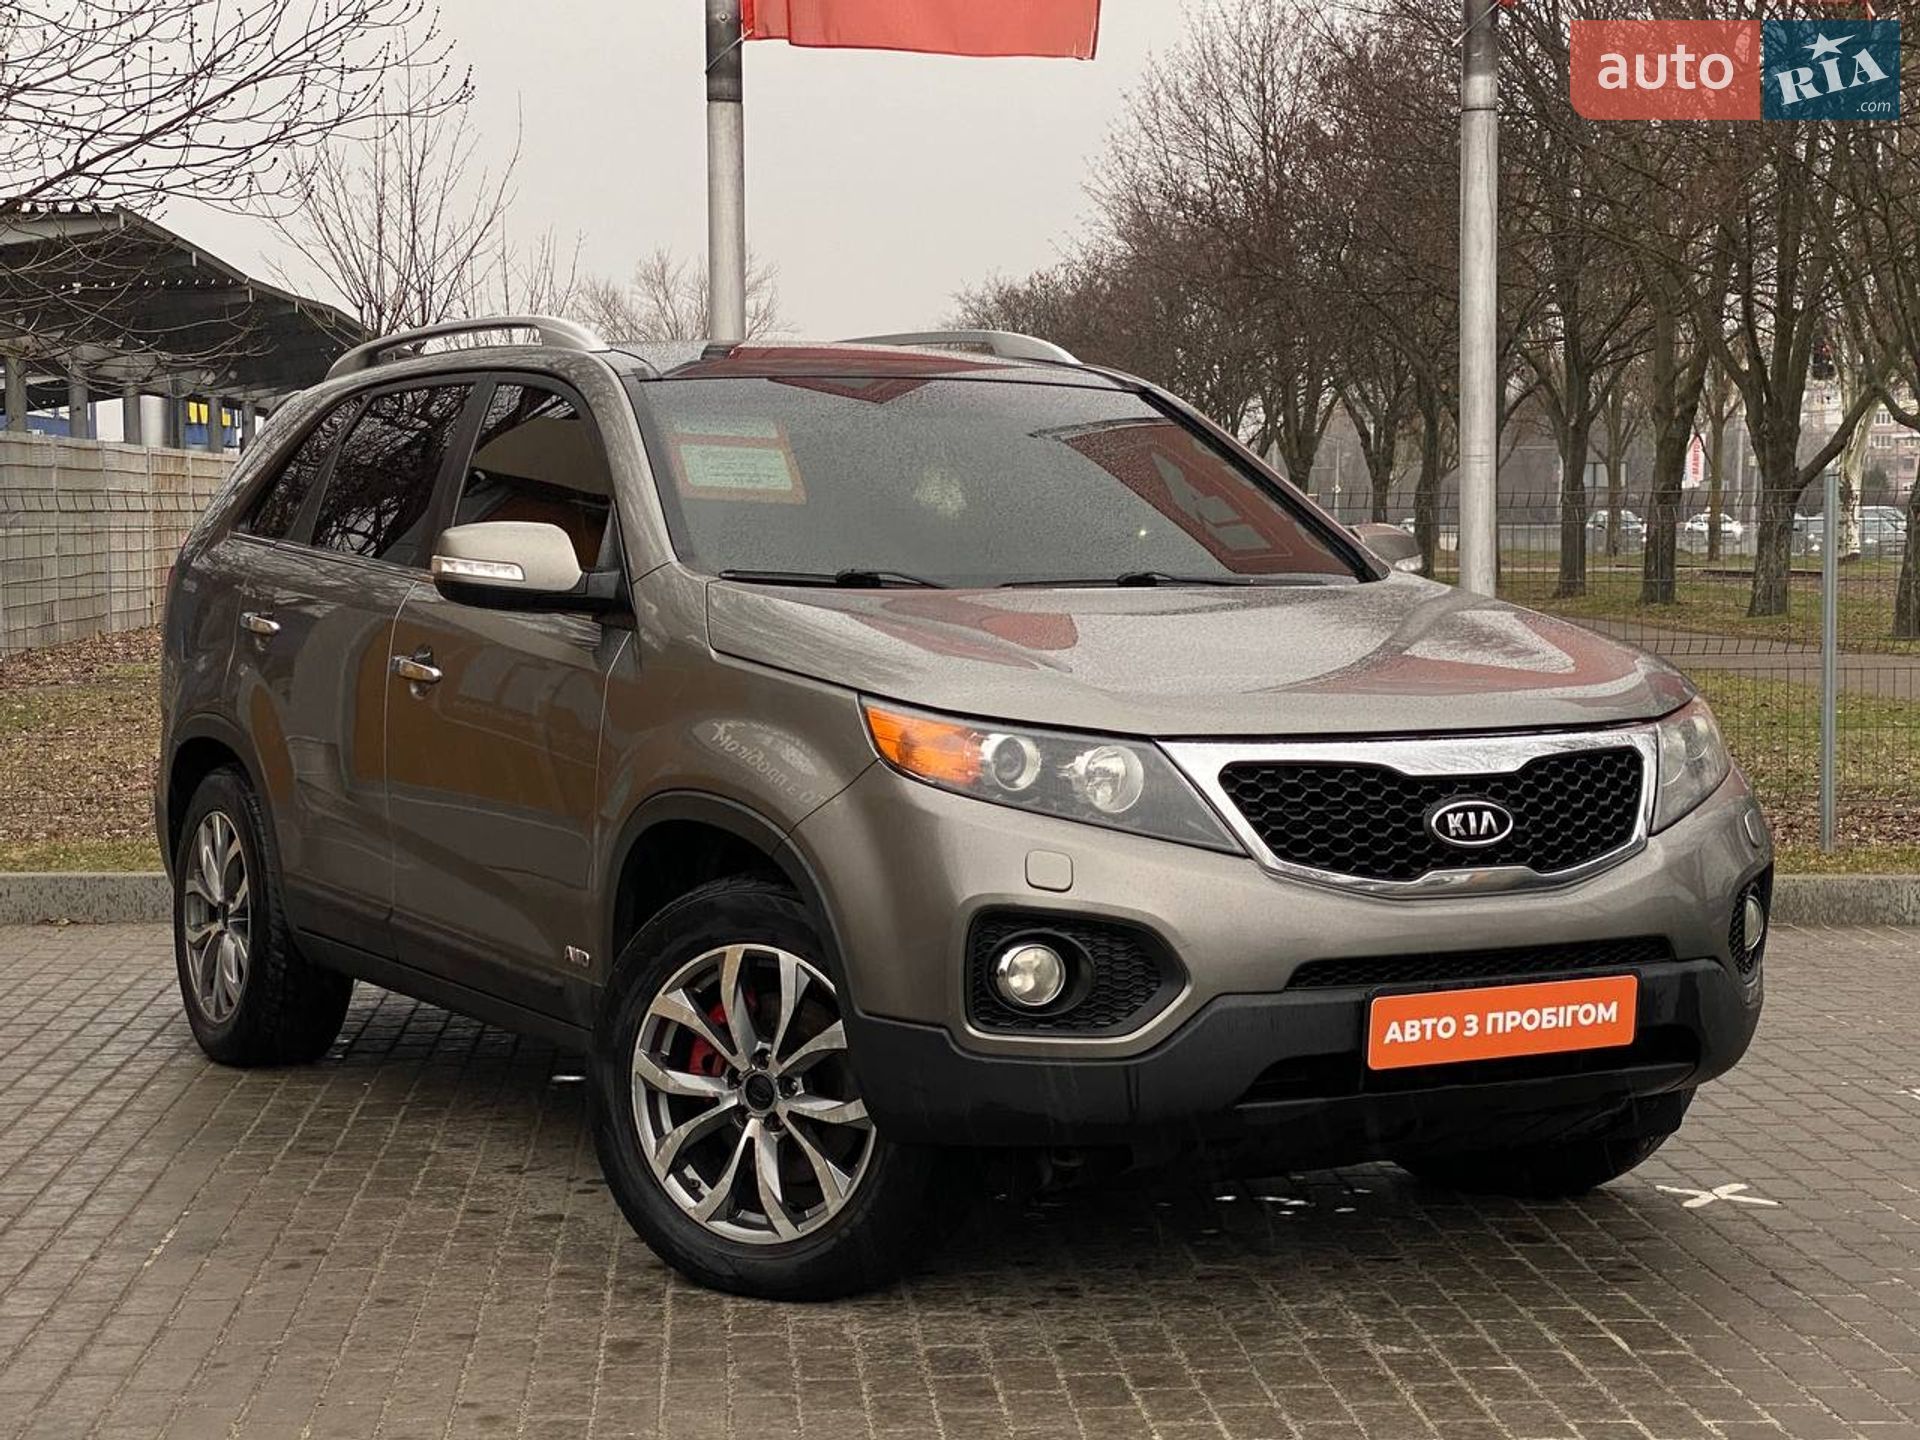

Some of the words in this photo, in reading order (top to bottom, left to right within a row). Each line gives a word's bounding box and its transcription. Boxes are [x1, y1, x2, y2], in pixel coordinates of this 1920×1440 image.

[1446, 811, 1499, 837] KIA
[1383, 1017, 1457, 1045] АВТО
[1463, 1014, 1479, 1037] З
[1486, 1001, 1619, 1035] ПРОБІГОМ
